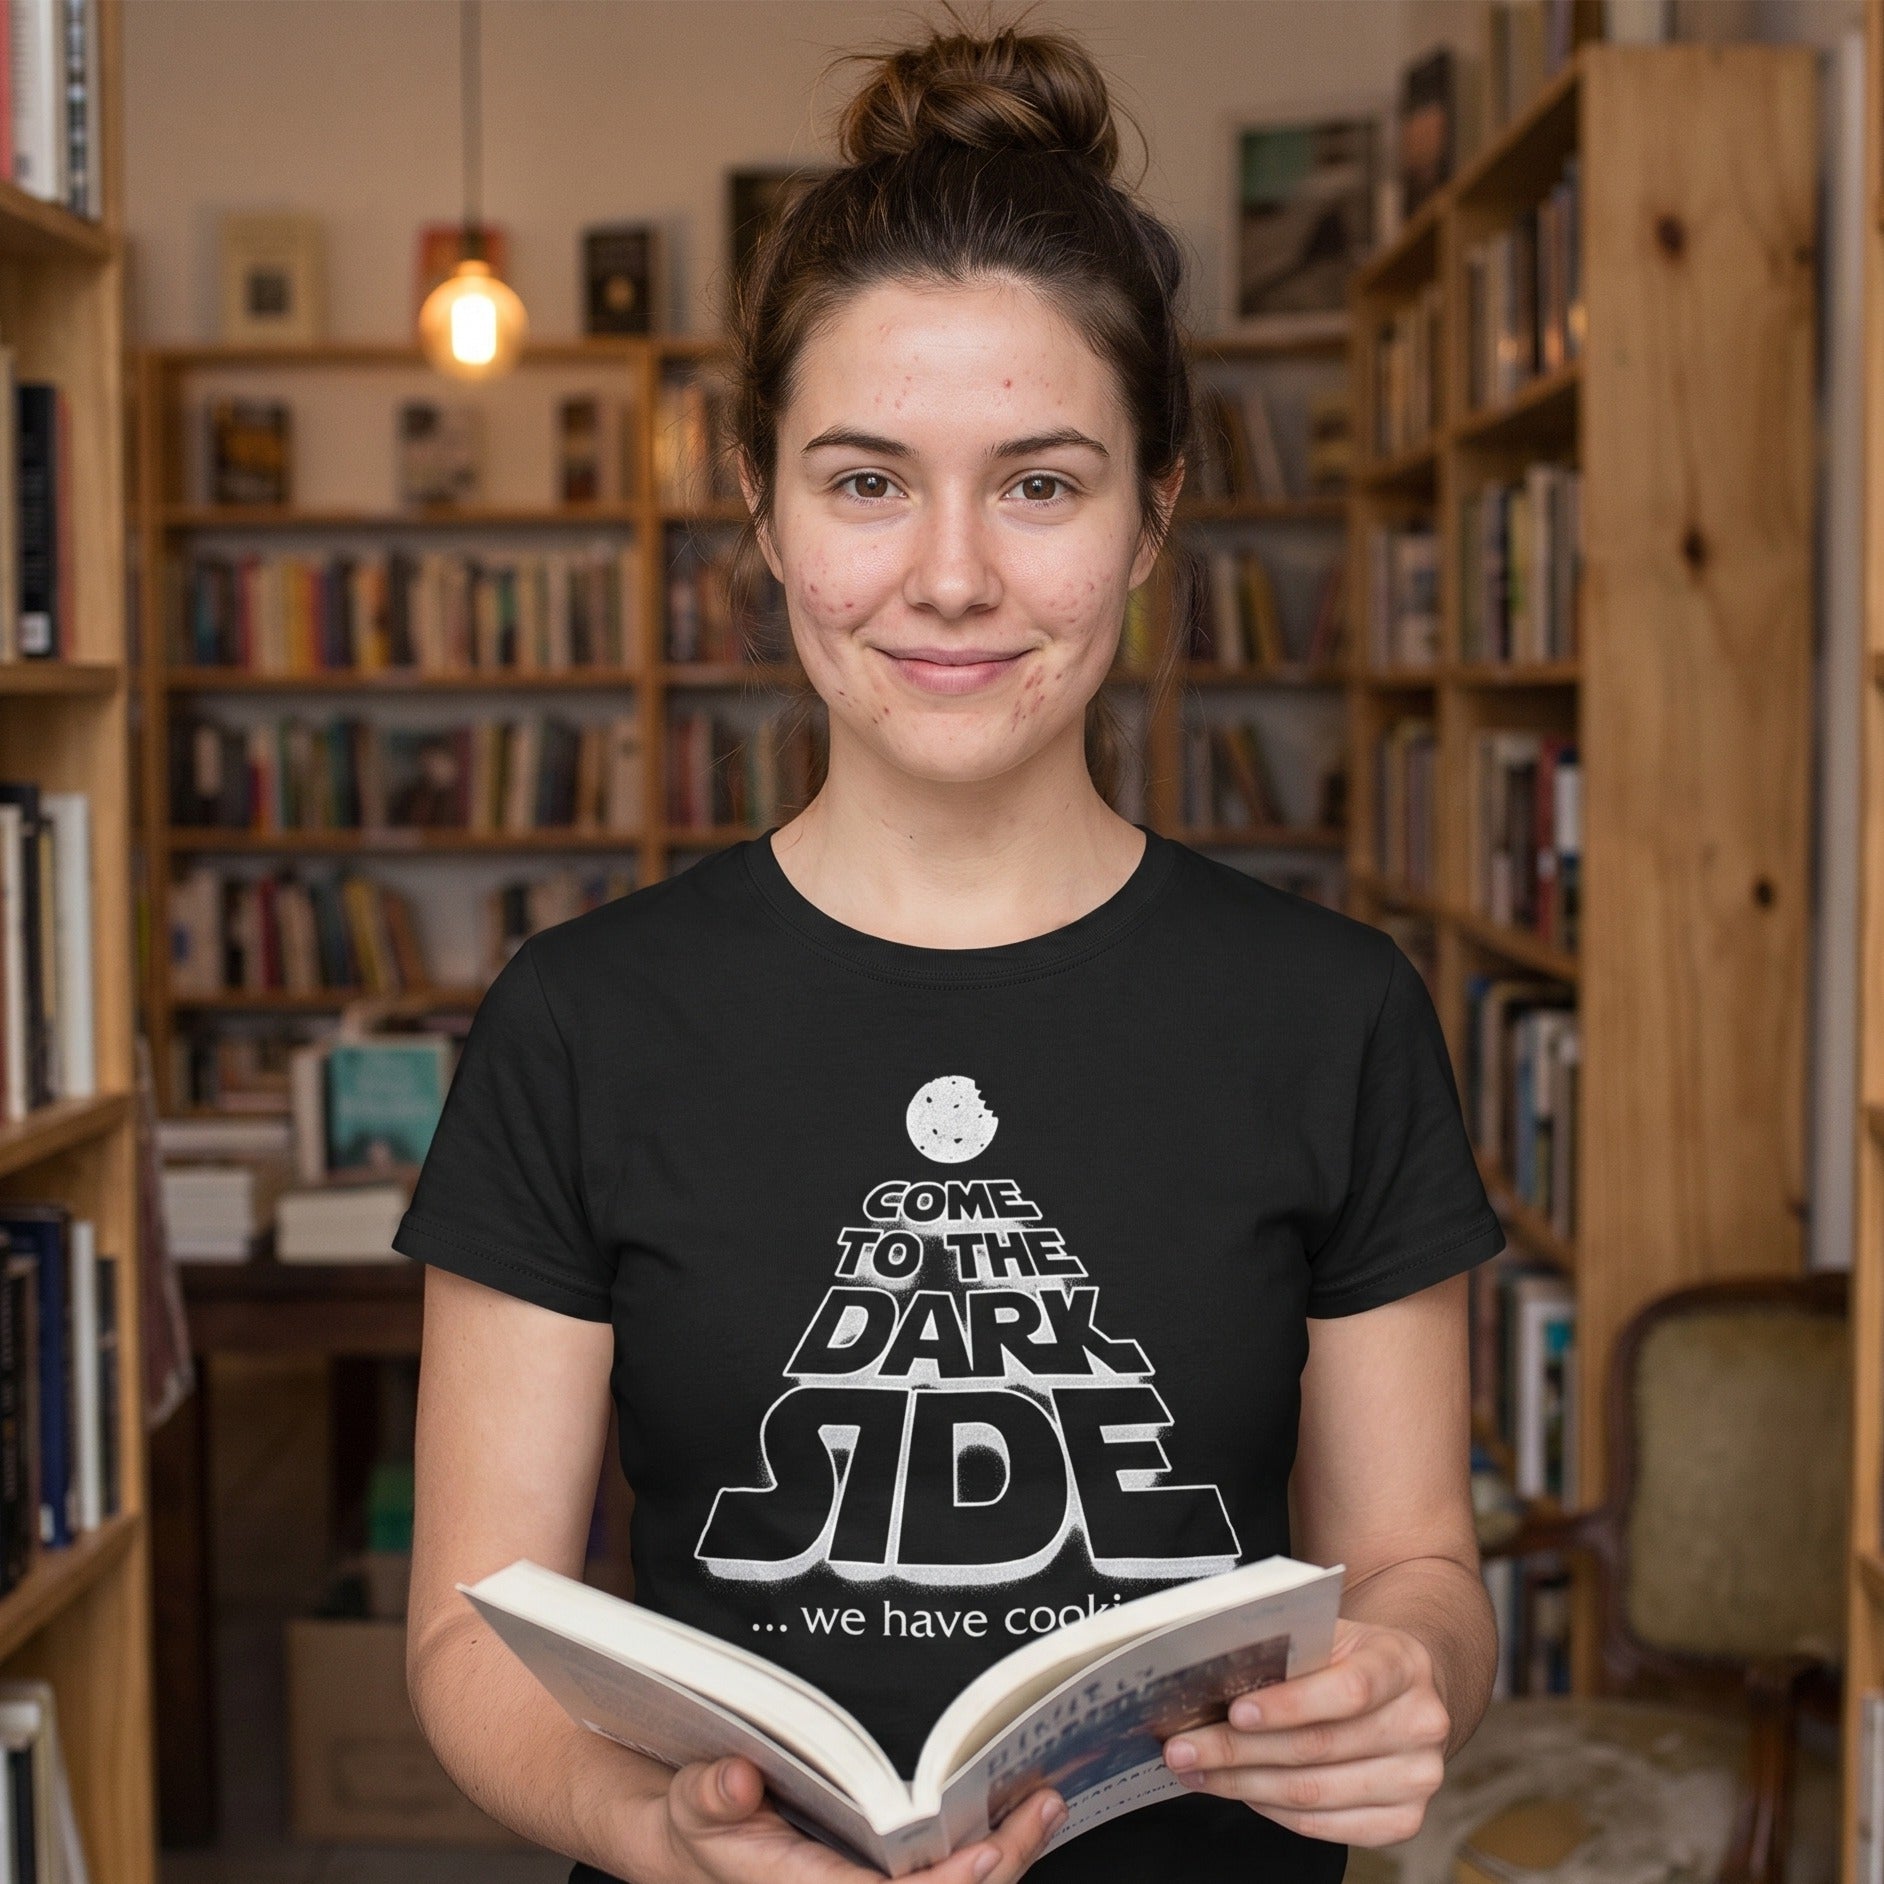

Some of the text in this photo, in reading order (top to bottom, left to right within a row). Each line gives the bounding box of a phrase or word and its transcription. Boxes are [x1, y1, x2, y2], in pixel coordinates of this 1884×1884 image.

[862, 1179, 1043, 1226] COME
[834, 1226, 1089, 1282] TO THE
[783, 1286, 1155, 1379] DARK
[694, 1384, 1242, 1570] SIDE
[800, 1607, 866, 1636] we
[883, 1600, 988, 1638] have
